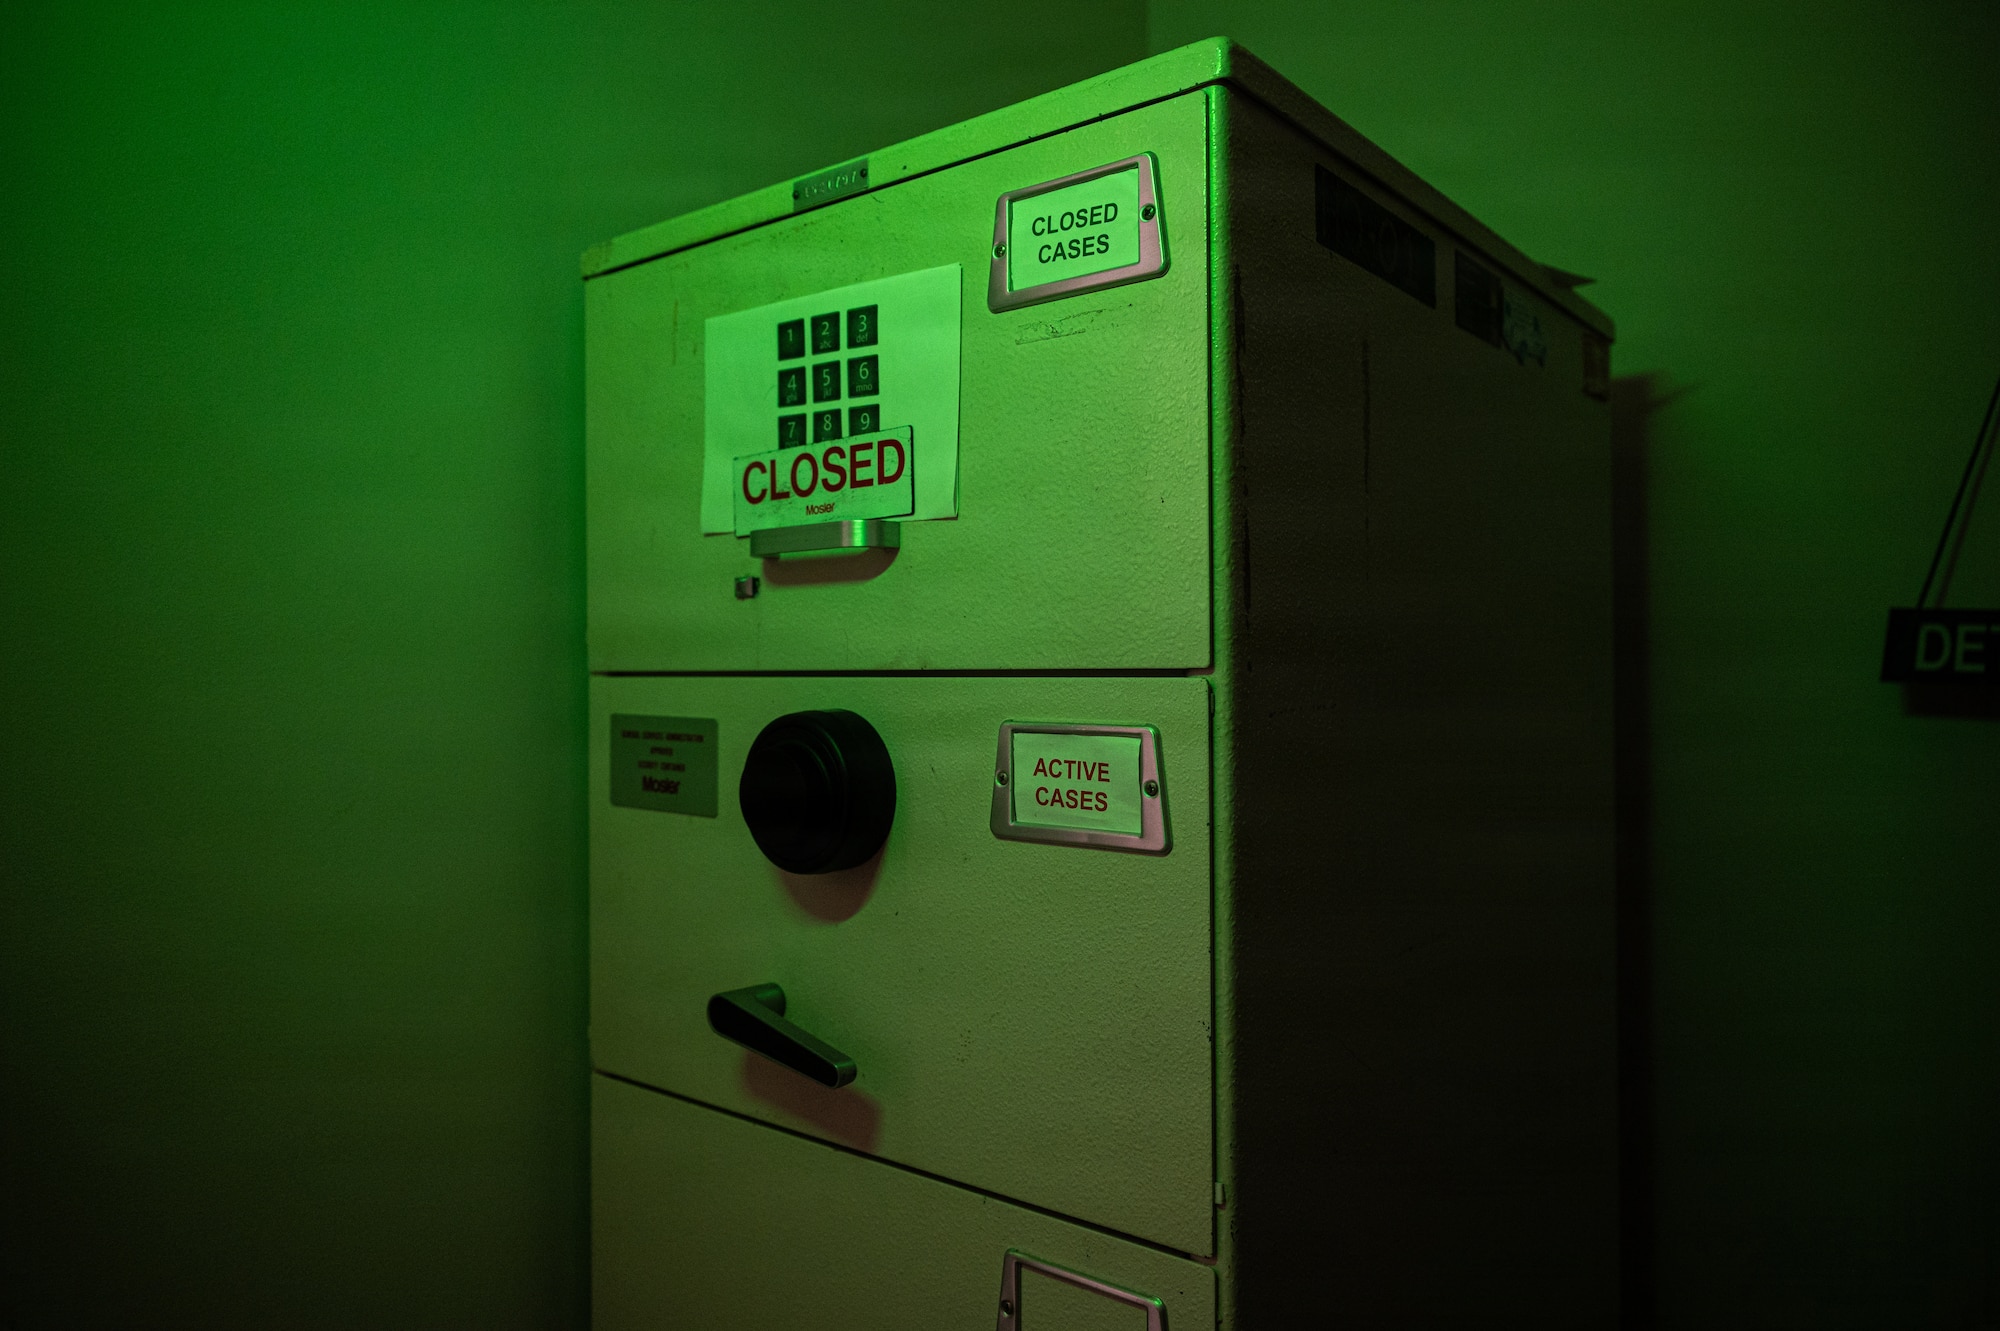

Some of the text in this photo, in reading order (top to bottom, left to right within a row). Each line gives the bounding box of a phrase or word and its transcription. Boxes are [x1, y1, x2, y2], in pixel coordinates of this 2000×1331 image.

[1031, 203, 1118, 237] CLOSED
[1038, 234, 1110, 264] CASES
[787, 314, 867, 342] 1 2 3
[855, 332, 869, 343] def
[786, 361, 870, 391] 4 5 6
[855, 383, 873, 393] mno
[787, 412, 871, 439] 7 8 9
[742, 439, 906, 505] CLOSED
[1032, 757, 1110, 783] ACTIVE
[1035, 786, 1108, 812] CASES
